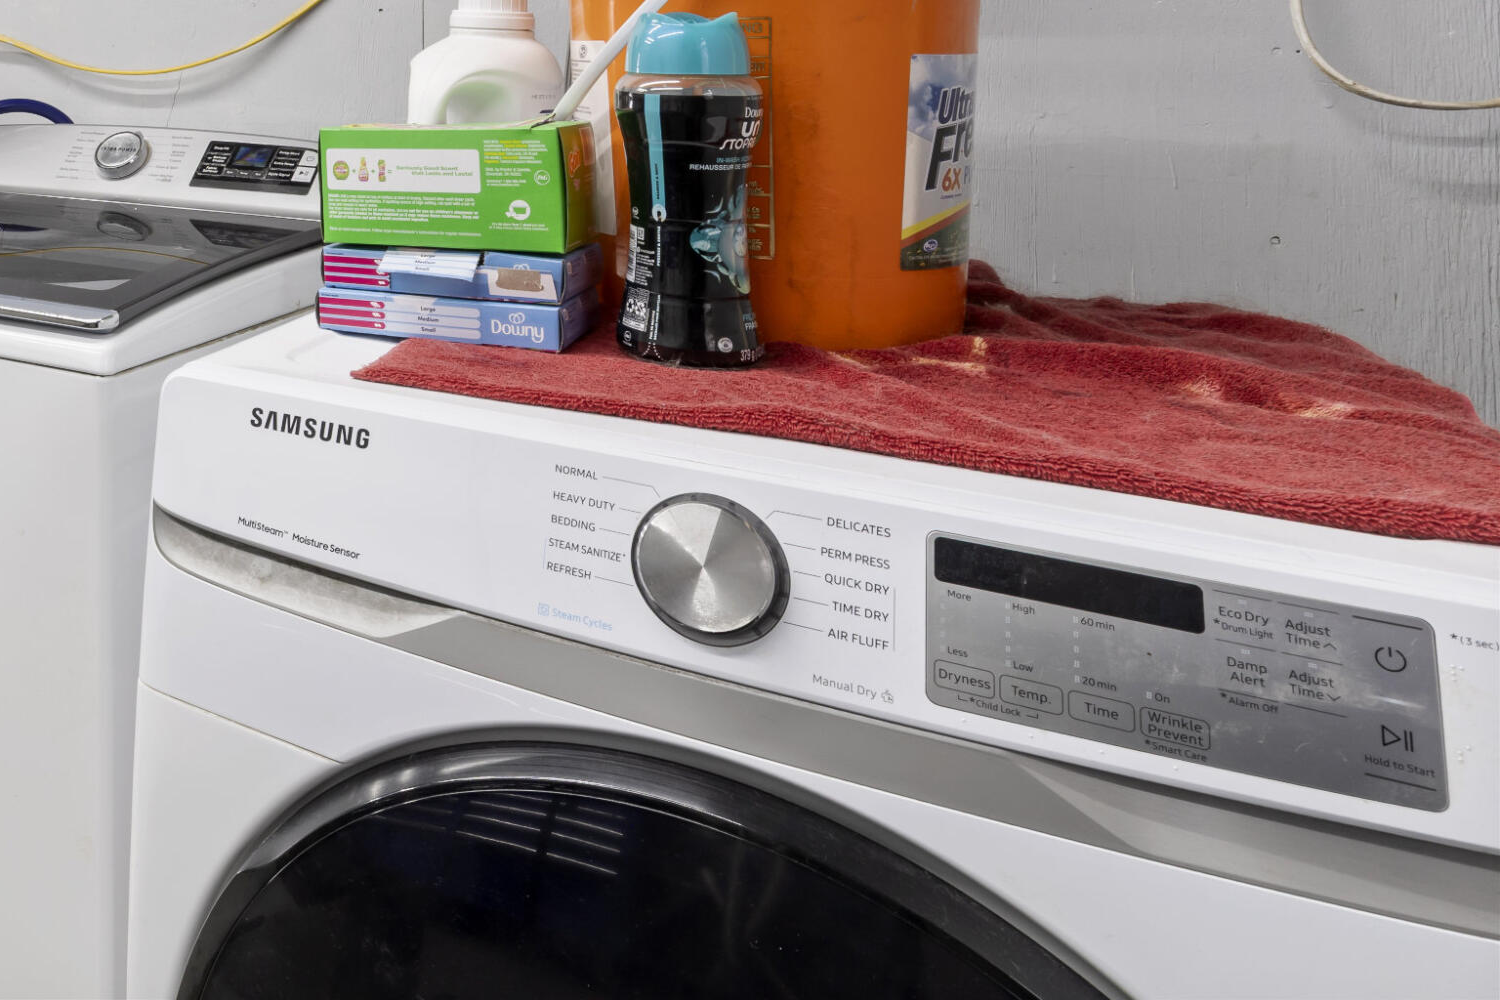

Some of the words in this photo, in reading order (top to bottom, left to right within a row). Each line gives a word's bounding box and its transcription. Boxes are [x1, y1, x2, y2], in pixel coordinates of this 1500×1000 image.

[420, 305, 437, 313] Large
[491, 319, 545, 343] Downy
[250, 407, 371, 449] SAMSUNG
[554, 464, 598, 480] NORMAL
[553, 491, 586, 506] HEAVY
[588, 497, 615, 512] DUTY
[550, 514, 596, 532] BEDDING
[826, 516, 892, 538] DELICATES
[292, 532, 329, 552] Moisture
[329, 543, 361, 560] Sensor
[548, 537, 580, 554] STEAM
[820, 547, 852, 563] PERM
[854, 553, 891, 570] PRESS
[546, 561, 592, 580] REFRESH
[824, 573, 862, 590] QUICK
[864, 582, 890, 596] DRY
[946, 589, 972, 602] More
[832, 601, 861, 617] TIME
[864, 608, 889, 623] DRY
[1012, 602, 1035, 616] High
[1218, 605, 1243, 621] Eco
[1244, 611, 1270, 627] Dry
[552, 606, 582, 624] Steam
[583, 614, 613, 632] Cycles
[1080, 616, 1094, 628] 60
[1094, 620, 1116, 632] min
[1284, 618, 1331, 638] Adjust
[828, 628, 849, 642] AIR
[851, 633, 890, 651] FLUFF
[1249, 625, 1274, 641] Light
[1285, 632, 1321, 650] Time
[947, 645, 968, 658] Less
[1013, 660, 1034, 673] Low
[1226, 656, 1268, 676] Damp
[812, 673, 854, 694] Manual
[856, 684, 878, 701] Dry
[938, 668, 991, 691] Dryness
[1082, 675, 1096, 687] 20
[1097, 680, 1118, 692] min
[1230, 671, 1266, 688] Alert
[1288, 669, 1334, 689] Adjust
[1154, 692, 1171, 704] On
[1290, 683, 1325, 701] Time
[1000, 704, 1021, 718] Lock
[1083, 702, 1119, 721] Time
[1262, 702, 1279, 714] Off
[1147, 710, 1203, 734] Wrinkle
[1147, 723, 1204, 747] Prevent
[1184, 748, 1208, 763] Care
[1364, 754, 1391, 769] Hold
[1392, 761, 1405, 771] to
[1406, 764, 1436, 779] Start
